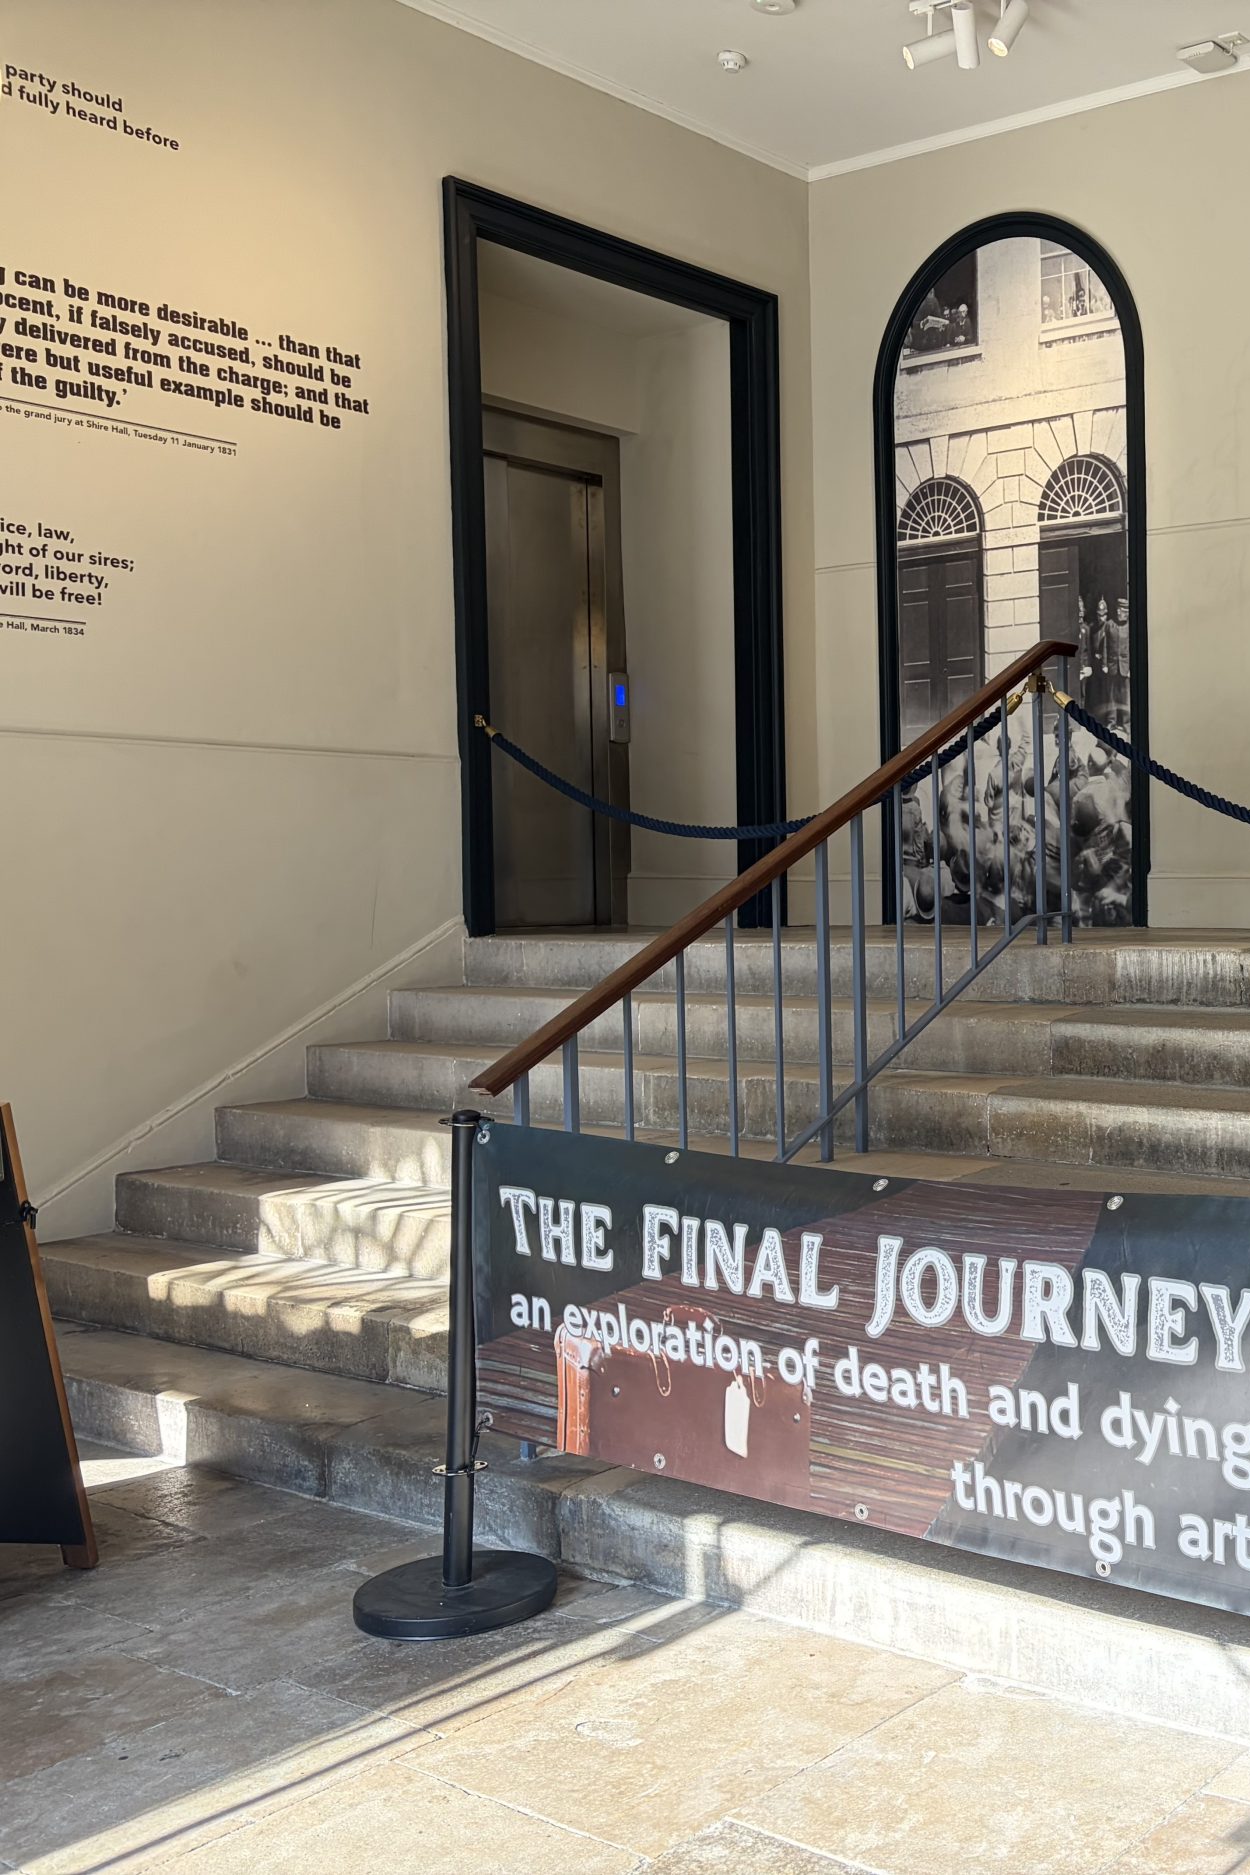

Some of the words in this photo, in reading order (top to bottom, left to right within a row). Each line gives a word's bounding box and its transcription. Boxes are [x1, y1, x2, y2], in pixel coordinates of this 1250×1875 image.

[5, 64, 57, 93] party
[62, 82, 123, 113] should
[2, 81, 12, 97] d
[18, 85, 60, 114] fully
[66, 100, 117, 131] heard
[123, 119, 180, 151] before
[14, 270, 56, 293] can
[63, 278, 90, 301] be
[97, 291, 150, 316] more
[157, 304, 248, 341] desirable
[278, 335, 320, 359] than
[326, 347, 361, 369] that
[68, 304, 83, 324] if
[91, 309, 161, 346] falsely
[168, 333, 256, 367] accused,
[262, 354, 324, 382] should
[330, 368, 352, 388] be
[1, 342, 38, 363] ere
[45, 347, 81, 373] but
[88, 361, 153, 389] useful
[160, 377, 245, 408] example
[250, 397, 314, 424] should
[319, 409, 341, 430] be
[11, 366, 47, 390] the
[15, 317, 117, 357] delivered
[124, 341, 172, 369] from
[178, 355, 210, 377] the
[217, 366, 288, 398] charge;
[295, 385, 329, 405] and
[334, 392, 370, 415] that
[5, 404, 21, 415] the
[24, 409, 51, 420] grand
[54, 414, 73, 426] jury
[74, 419, 84, 427] at
[86, 420, 109, 432] Shire
[111, 425, 130, 437] Hall,
[133, 429, 168, 445] Tuesday
[170, 437, 180, 446] 11
[182, 439, 215, 454] January
[217, 446, 237, 457] 1831
[0, 517, 32, 538] ice,
[38, 522, 75, 544] law,
[0, 563, 39, 580] ord,
[45, 564, 109, 589] liberty,
[29, 544, 48, 558] of
[53, 549, 84, 563] our
[89, 552, 134, 572] sires;
[32, 583, 55, 600] be
[60, 587, 102, 606] free!
[7, 621, 28, 631] Hall,
[31, 623, 60, 634] March
[63, 627, 85, 636] 1834
[510, 1293, 552, 1332] an
[563, 1303, 763, 1377] exploration
[778, 1337, 819, 1389] of
[834, 1346, 970, 1419] death
[988, 1382, 1083, 1440] and
[951, 1459, 1156, 1564] through
